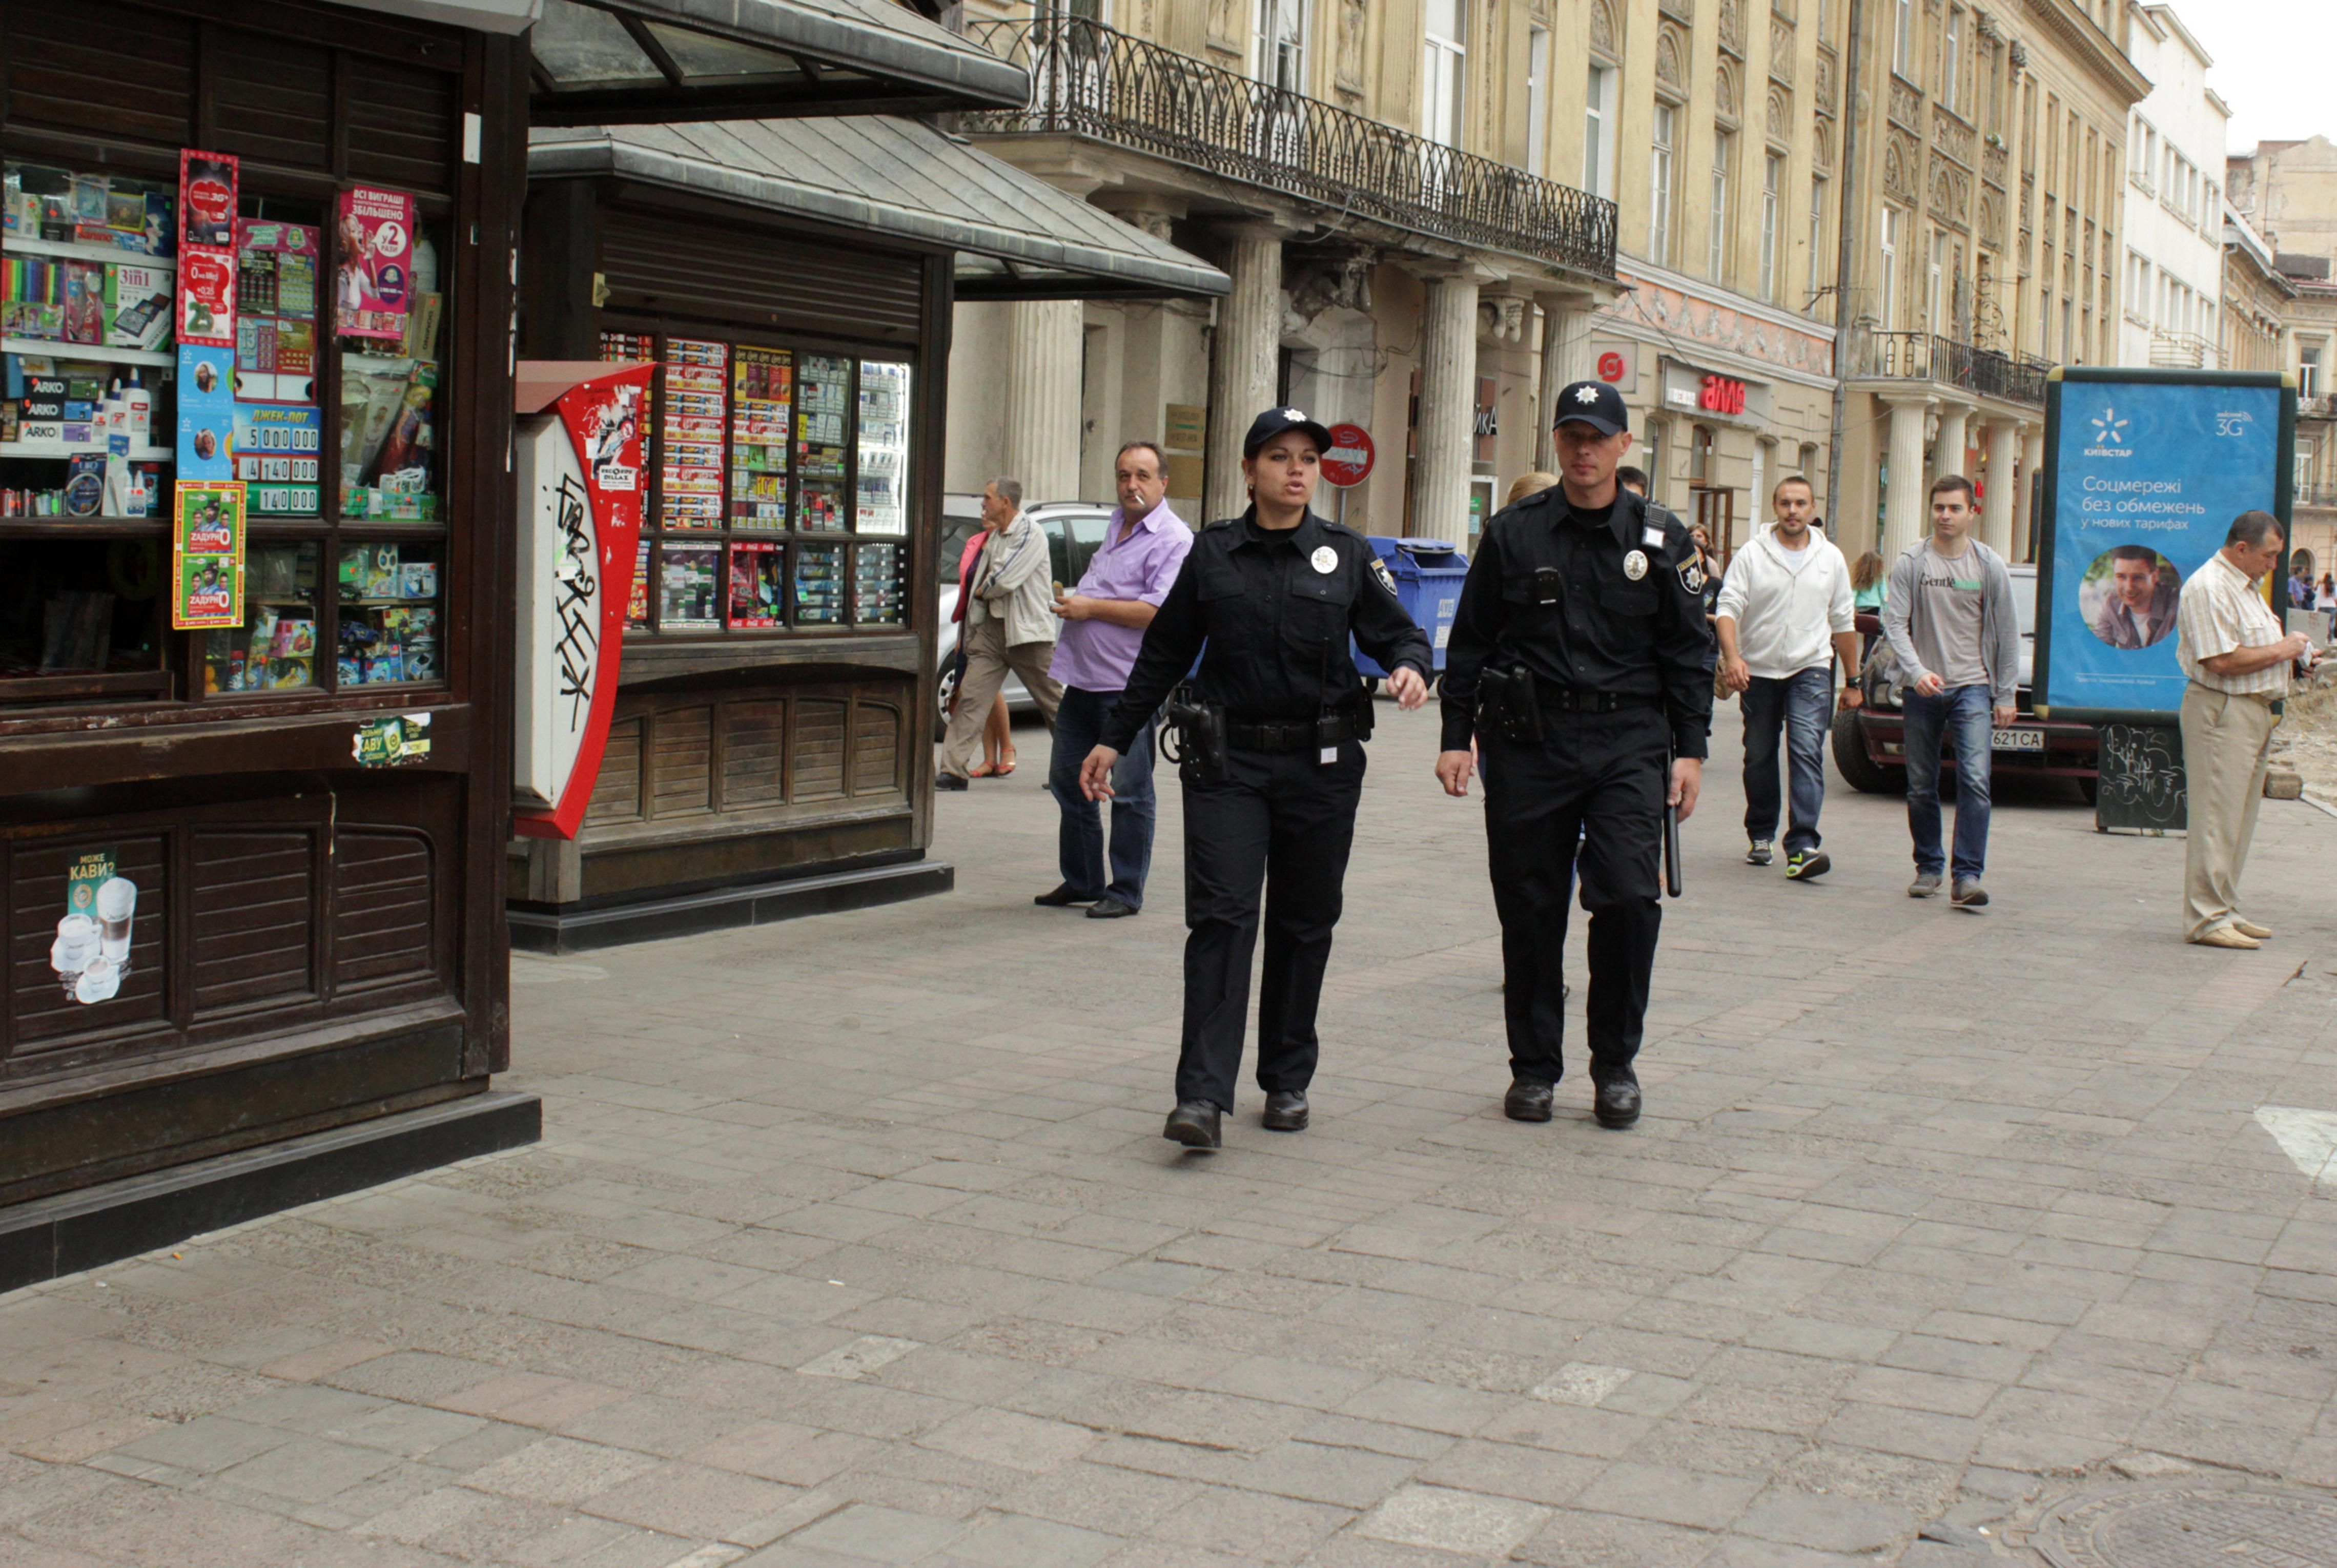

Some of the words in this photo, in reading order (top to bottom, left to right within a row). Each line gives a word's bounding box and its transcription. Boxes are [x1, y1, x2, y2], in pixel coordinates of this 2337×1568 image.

[354, 190, 366, 199] ВСІ
[368, 192, 404, 204] ВИГРАШІ
[352, 204, 404, 220] ЗБІЛЬШЕНО
[388, 225, 398, 245] 2
[381, 244, 398, 253] РАЗИ
[120, 269, 150, 286] 3in1
[33, 382, 64, 394] ARKO
[28, 404, 58, 416] ARKO
[252, 409, 309, 423] ДЖЕК-ПОТ
[25, 427, 56, 437] ARKO
[2216, 419, 2243, 436] 3G
[294, 430, 317, 448] 000
[293, 462, 316, 479] 000
[2082, 476, 2182, 496] Соцмережі
[293, 490, 315, 508] 000
[2082, 496, 2112, 512] без
[2116, 498, 2206, 514] обмежень
[2081, 518, 2089, 529] у
[2092, 519, 2131, 528] нових
[2135, 519, 2189, 531] тарифах
[80, 853, 105, 864] МОЖЕ
[70, 862, 115, 880] КАВИ?
